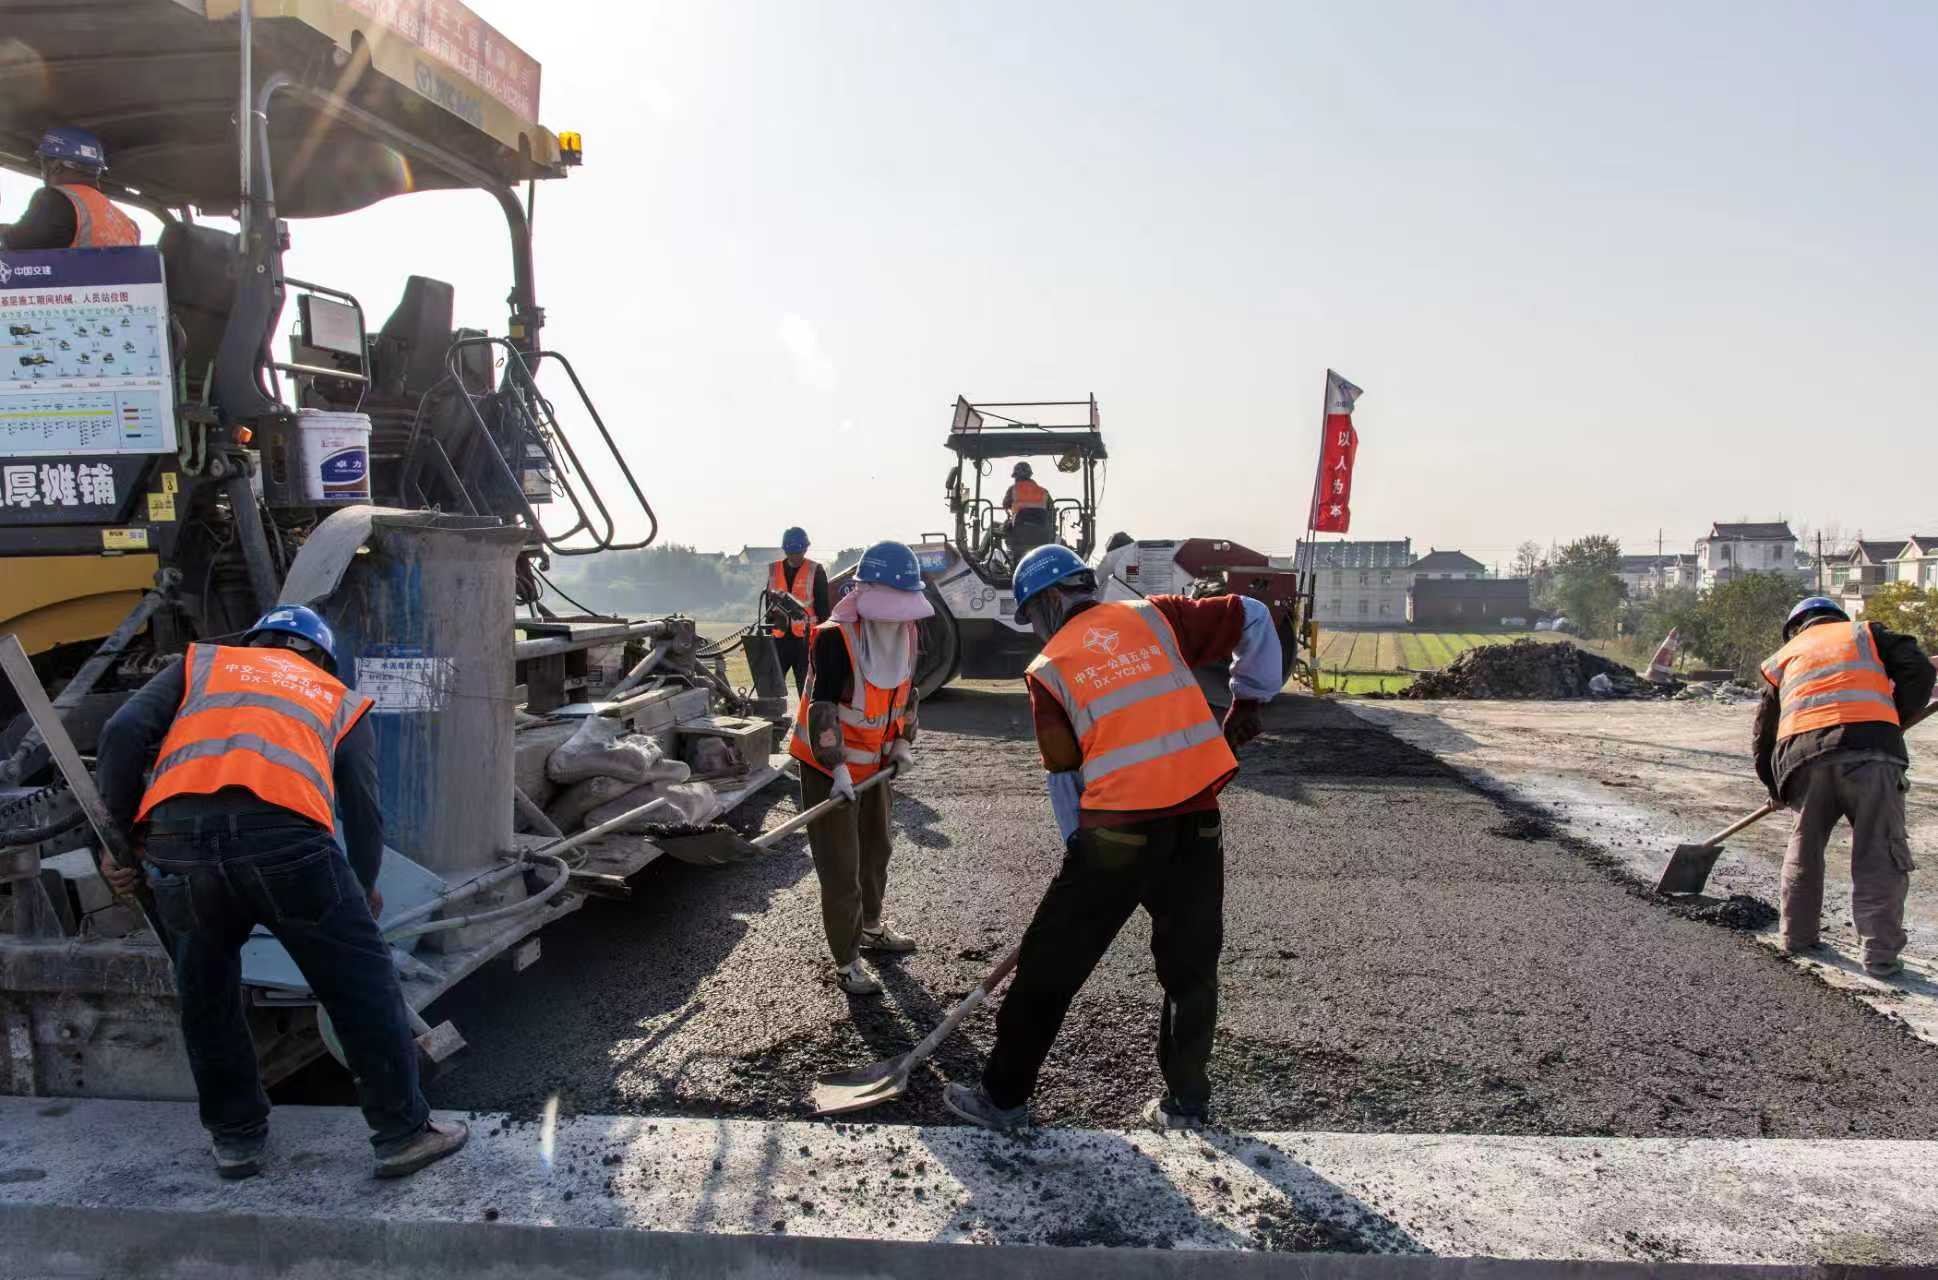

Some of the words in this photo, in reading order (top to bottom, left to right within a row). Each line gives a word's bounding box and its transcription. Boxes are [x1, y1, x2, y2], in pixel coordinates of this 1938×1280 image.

[15, 266, 52, 276] 中国交建
[0, 462, 117, 508] 厚摊铺
[1330, 432, 1350, 517] 以人为本
